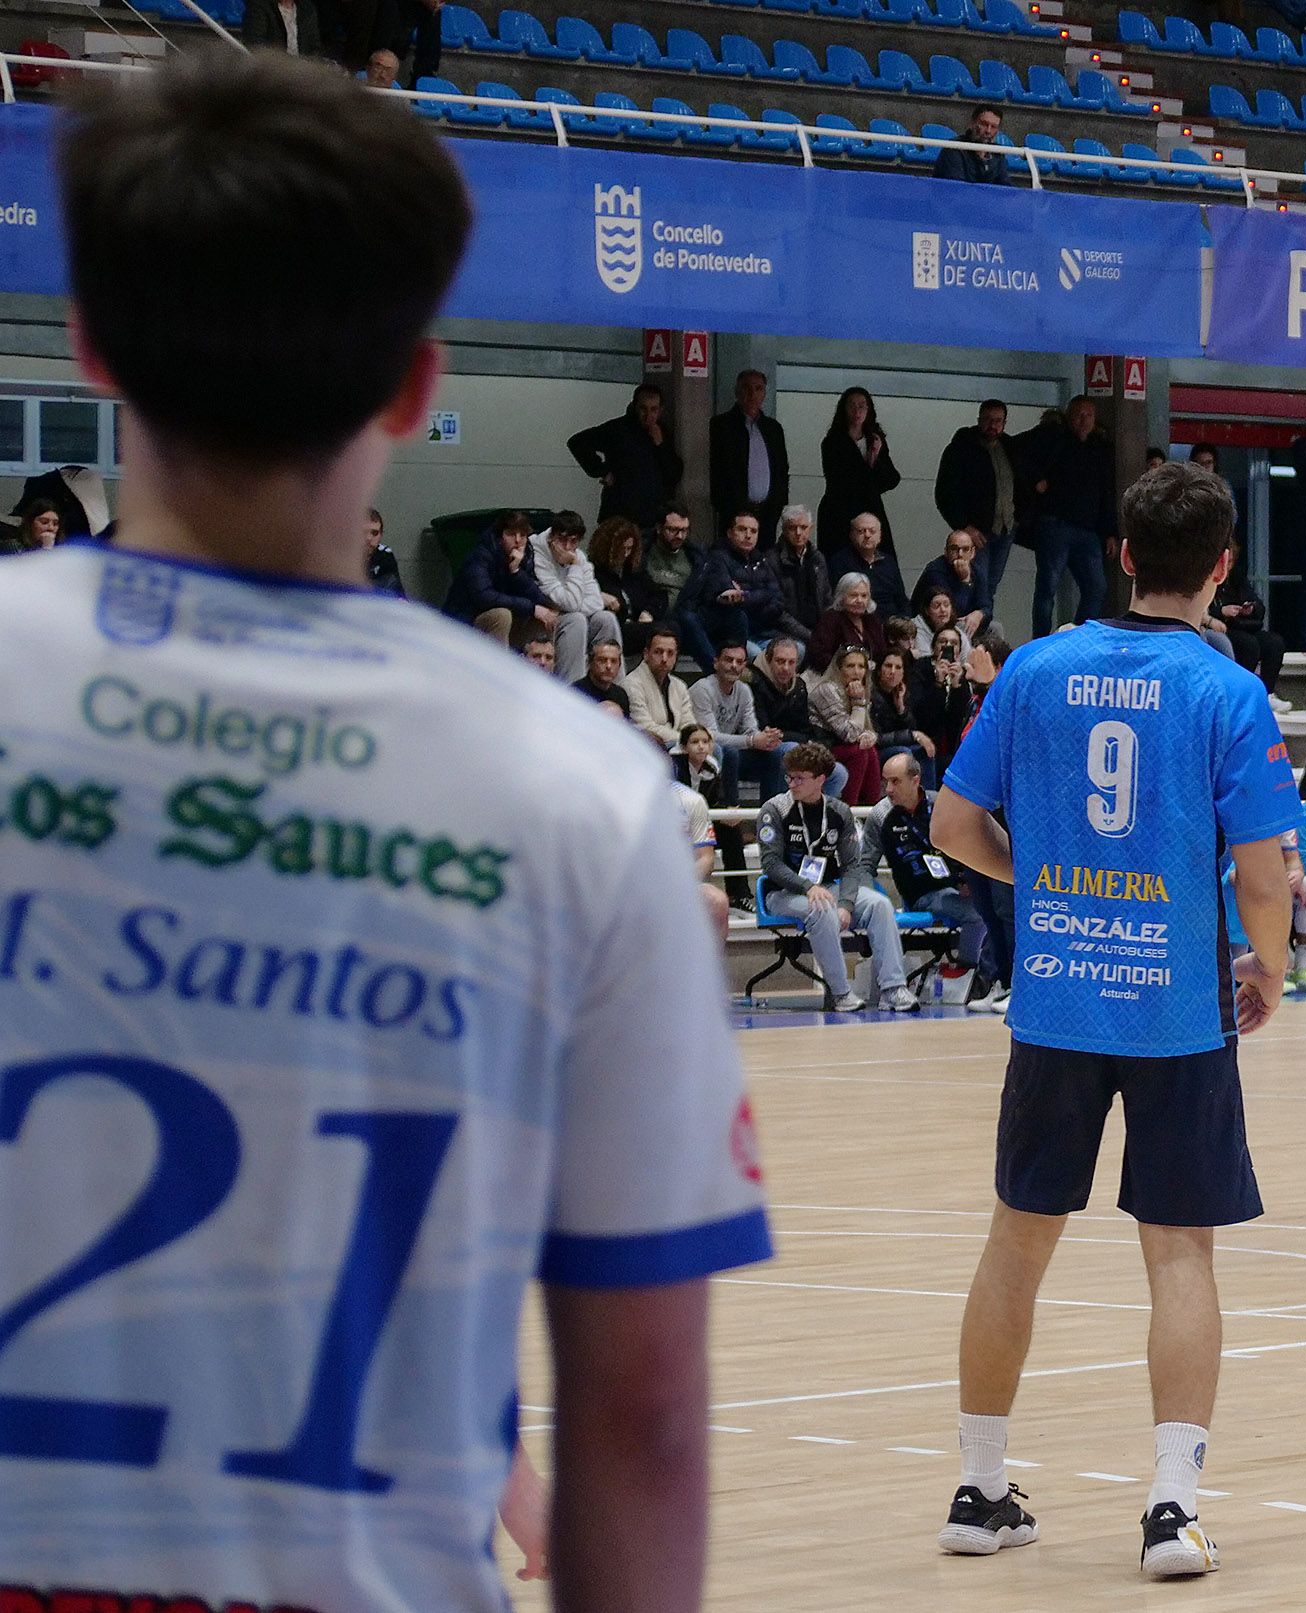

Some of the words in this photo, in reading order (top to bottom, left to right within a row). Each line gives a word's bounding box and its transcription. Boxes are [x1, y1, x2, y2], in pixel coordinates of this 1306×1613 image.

[652, 220, 724, 245] Concello
[653, 247, 675, 269] de
[678, 248, 772, 274] Pontevedra
[945, 240, 1004, 264] XUNTA
[1084, 250, 1124, 265] DEPORTE
[944, 265, 967, 287] DE
[972, 267, 1040, 291] GALICIA
[1084, 265, 1121, 280] GALEGO
[649, 333, 667, 358] A
[687, 337, 705, 362] A
[1091, 360, 1109, 383] A
[1127, 363, 1143, 386] A
[1066, 674, 1162, 711] GRANDA
[80, 673, 378, 778] Colegio
[1087, 720, 1139, 839] 9
[0, 770, 120, 850] os
[157, 774, 515, 909] Sauces
[1033, 863, 1170, 902] ALIMERKA
[1031, 899, 1071, 912] HNOS.
[1029, 911, 1168, 944] GONZÁLEZ
[1095, 944, 1168, 958] AUTOBUSES
[100, 903, 482, 1043] Santos
[1068, 960, 1171, 986] HYUNDAI
[1100, 987, 1140, 1000] Asturdai
[0, 1053, 463, 1496] 21
